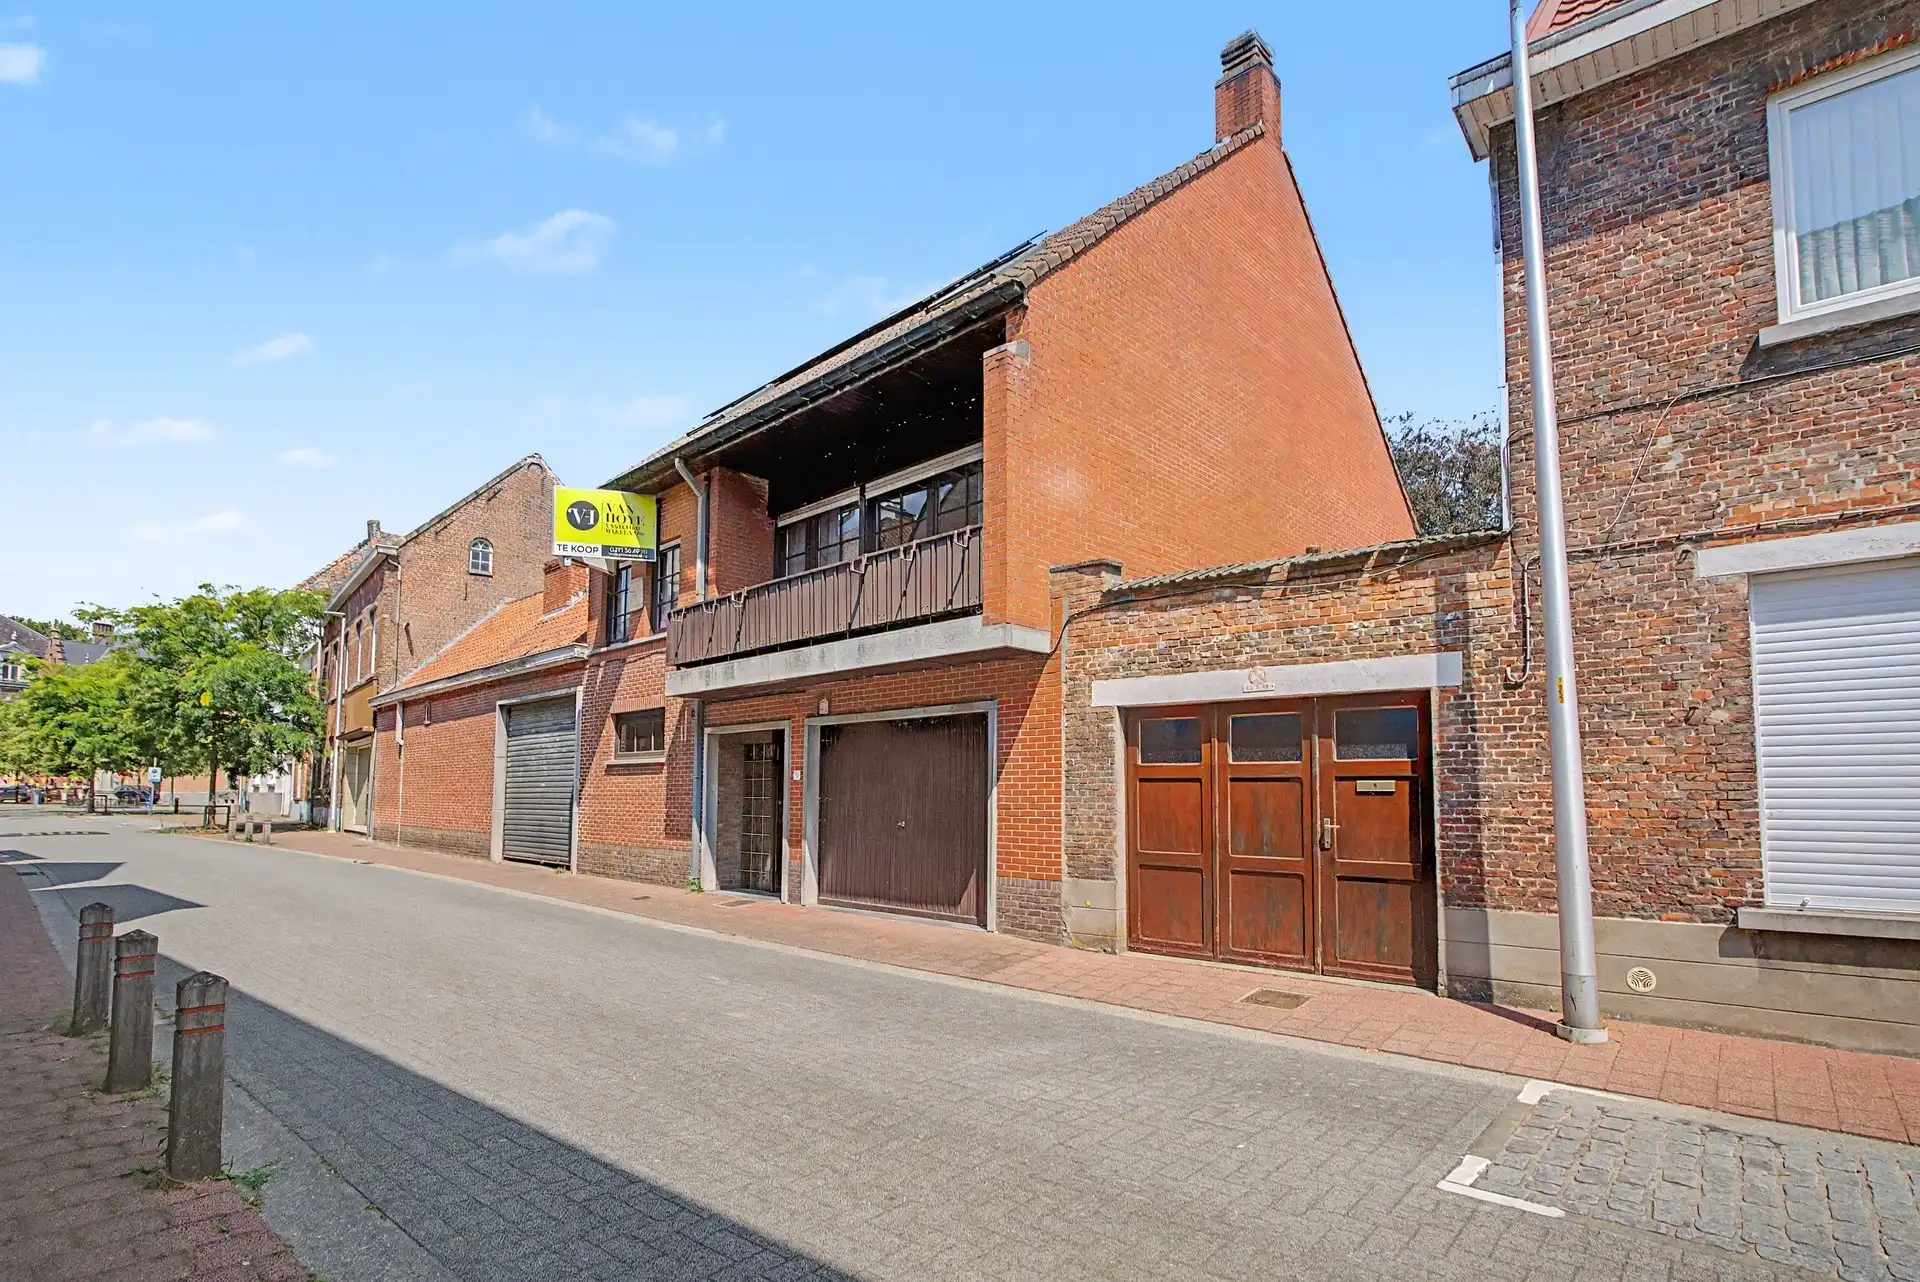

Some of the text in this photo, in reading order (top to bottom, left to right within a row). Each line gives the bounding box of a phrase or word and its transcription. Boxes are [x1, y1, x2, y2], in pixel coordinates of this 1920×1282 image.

[605, 503, 635, 514] VAN
[606, 513, 645, 526] HOYE
[557, 544, 599, 554] TE KOOP
